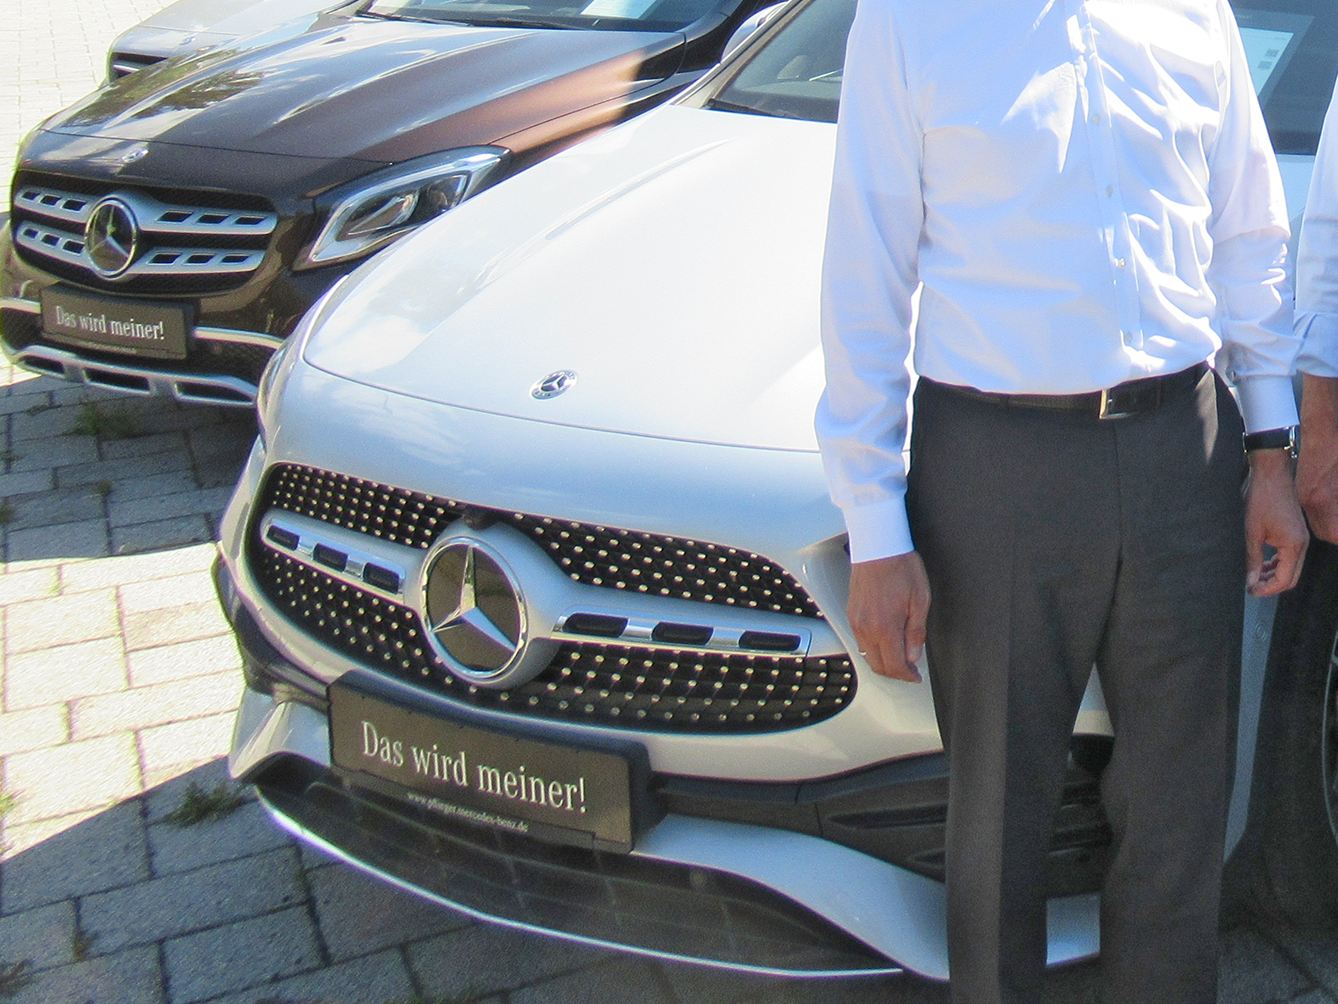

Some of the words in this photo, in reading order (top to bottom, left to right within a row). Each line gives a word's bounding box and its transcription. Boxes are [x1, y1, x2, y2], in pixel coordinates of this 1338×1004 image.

[55, 305, 77, 328] Das
[79, 312, 107, 334] wird
[110, 318, 166, 341] meiner!
[360, 720, 404, 767] Das
[410, 744, 469, 787] wird
[476, 765, 588, 814] meiner!
